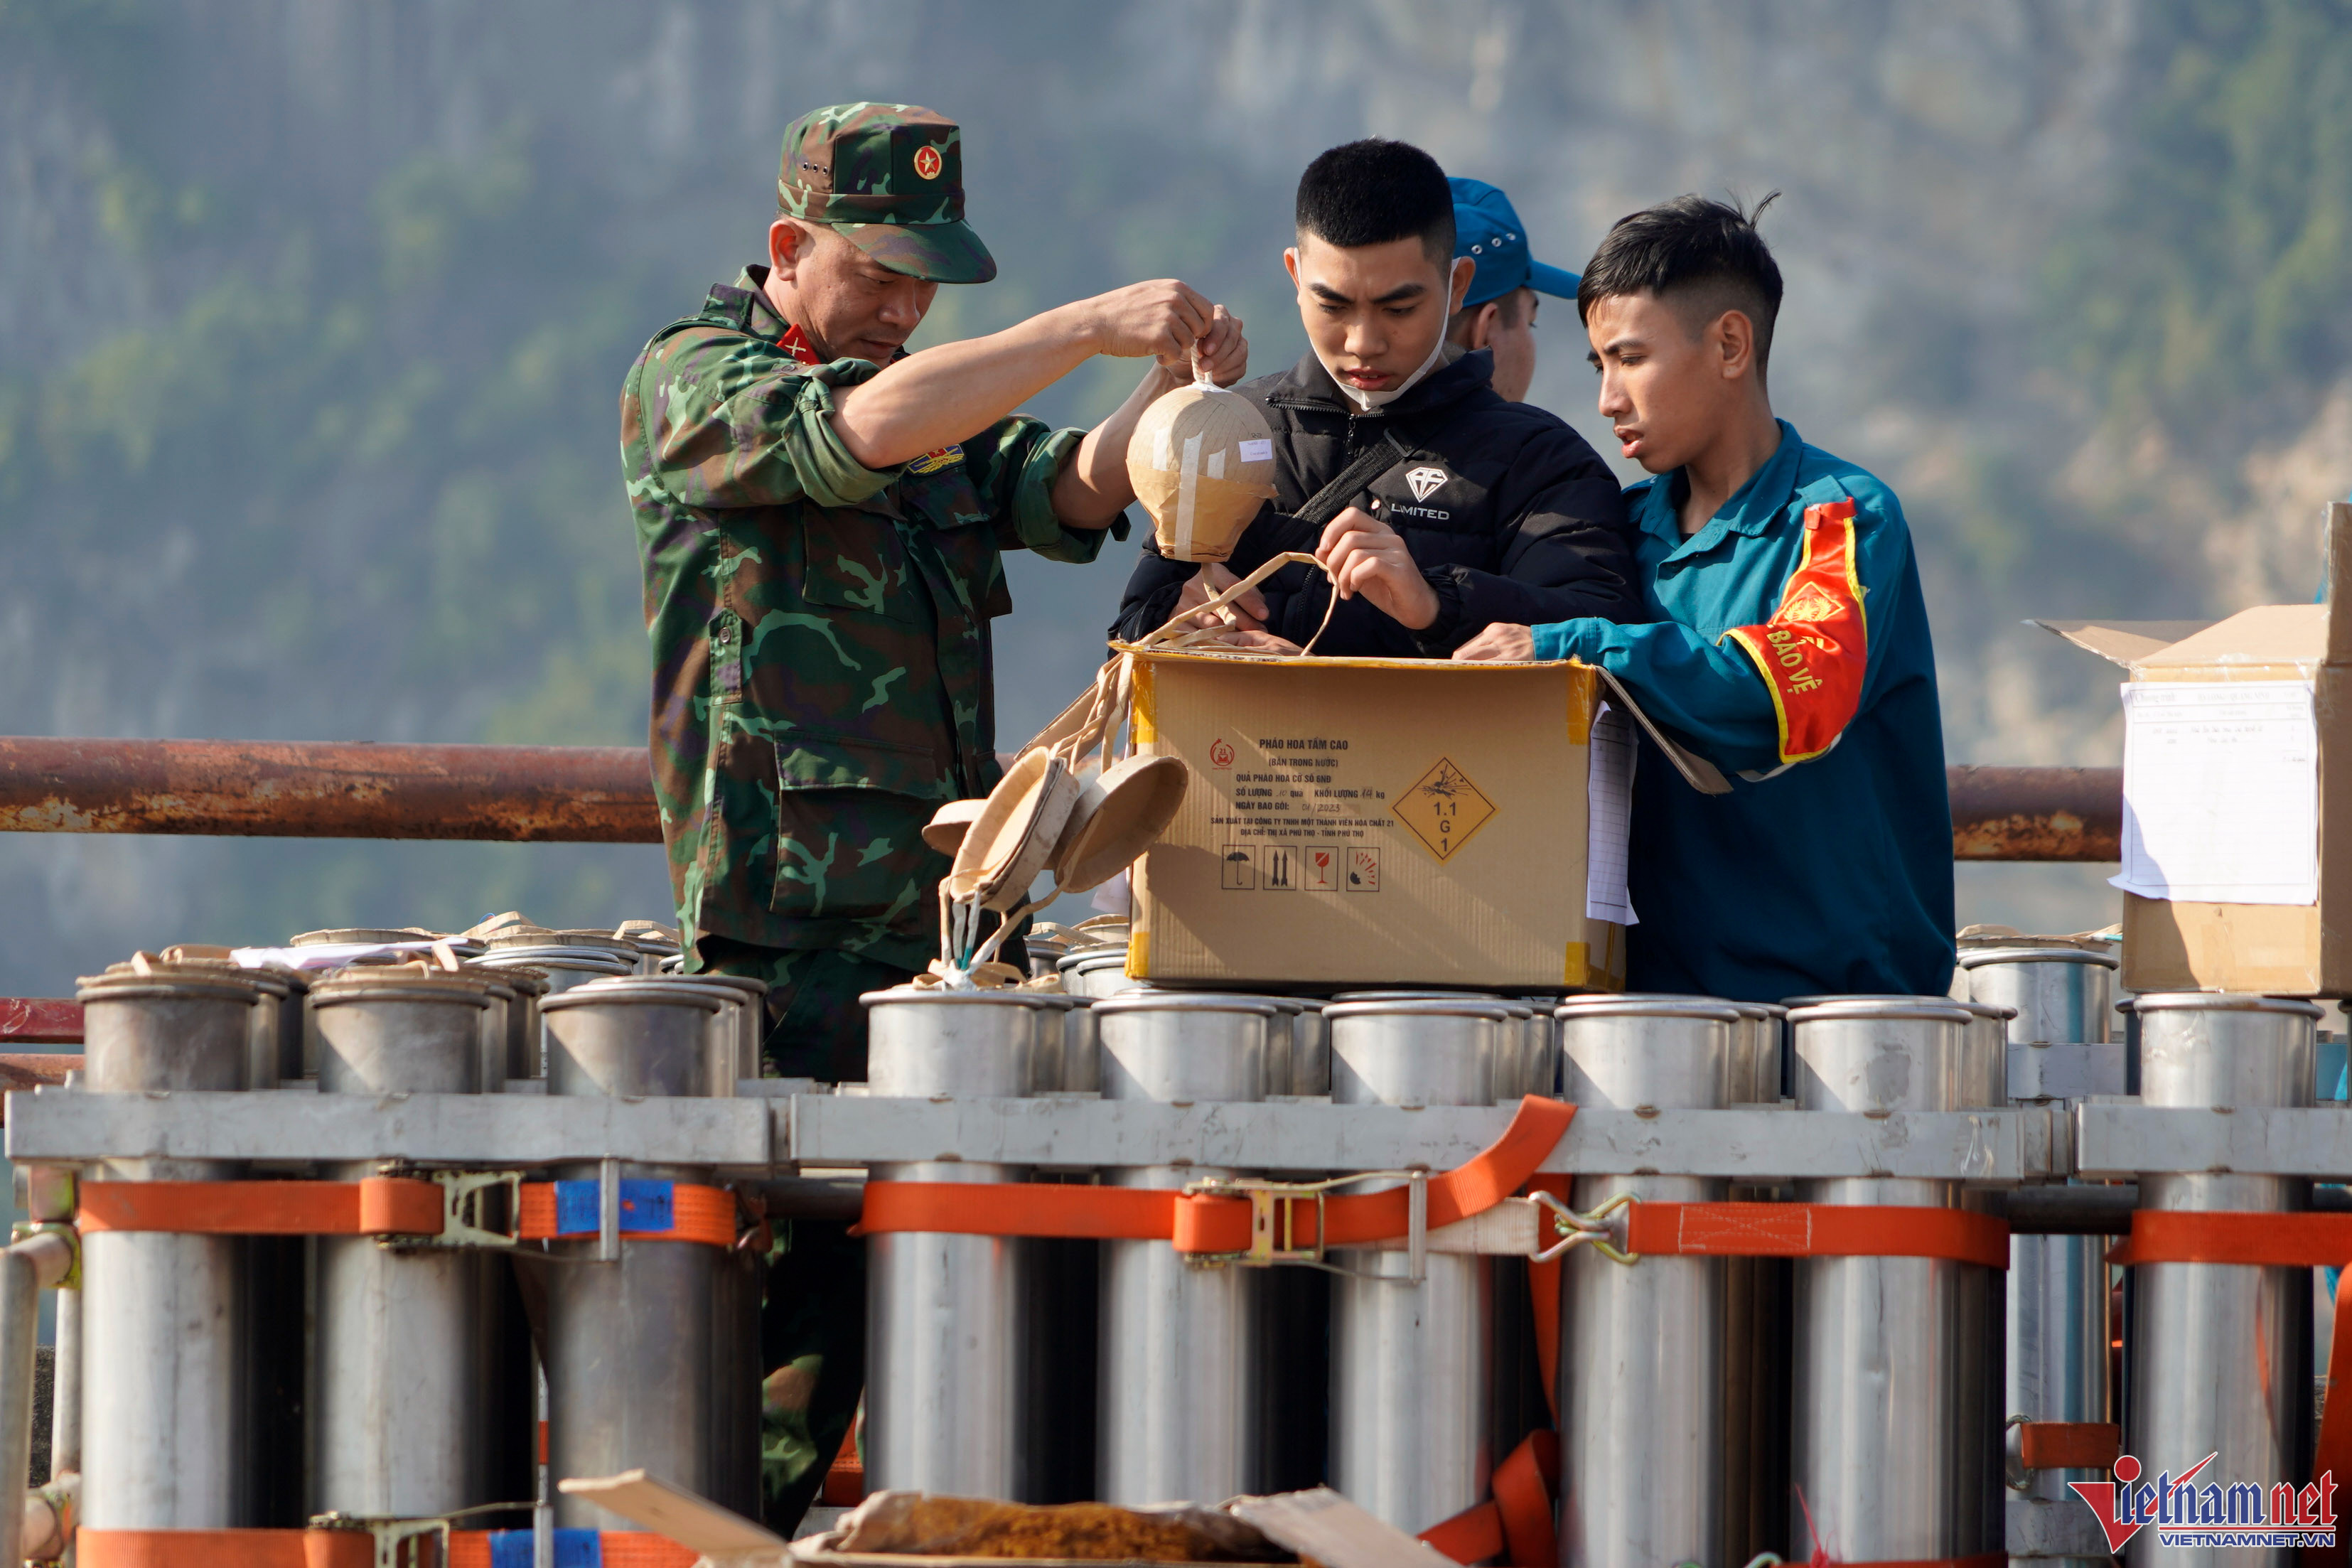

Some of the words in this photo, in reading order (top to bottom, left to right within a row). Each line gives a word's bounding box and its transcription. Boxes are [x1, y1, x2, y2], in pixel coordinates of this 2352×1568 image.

[1391, 503, 1449, 520] LIMITED
[1766, 630, 1806, 667] BẢO
[1787, 667, 1823, 694] VỆ
[1260, 736, 1284, 749] PHÁO
[1287, 739, 1305, 750] HOA
[1330, 739, 1348, 751] CAO
[1289, 758, 1314, 767] TRONG
[1236, 770, 1251, 783] QUẢ
[1275, 774, 1290, 783] HOA
[1235, 785, 1246, 796] SỐ
[1247, 788, 1272, 798] LƯỢNG
[1290, 788, 1304, 798] quả
[1314, 786, 1332, 798] KHỐI
[1333, 789, 1358, 800] LƯỢNG
[1375, 790, 1385, 799] kg
[1235, 800, 1255, 810] NGÀY
[1257, 802, 1273, 810] BAO
[1274, 800, 1289, 810] GÓI:
[1434, 802, 1456, 816] 1.1
[1210, 815, 1223, 825] SẢN
[1255, 817, 1272, 825] CÔNG
[1338, 818, 1353, 827] VIÊN
[1440, 820, 1450, 833] G
[1253, 827, 1265, 836] CHỈ:
[1321, 827, 1336, 837] TỈNH
[1441, 837, 1447, 852] 1
